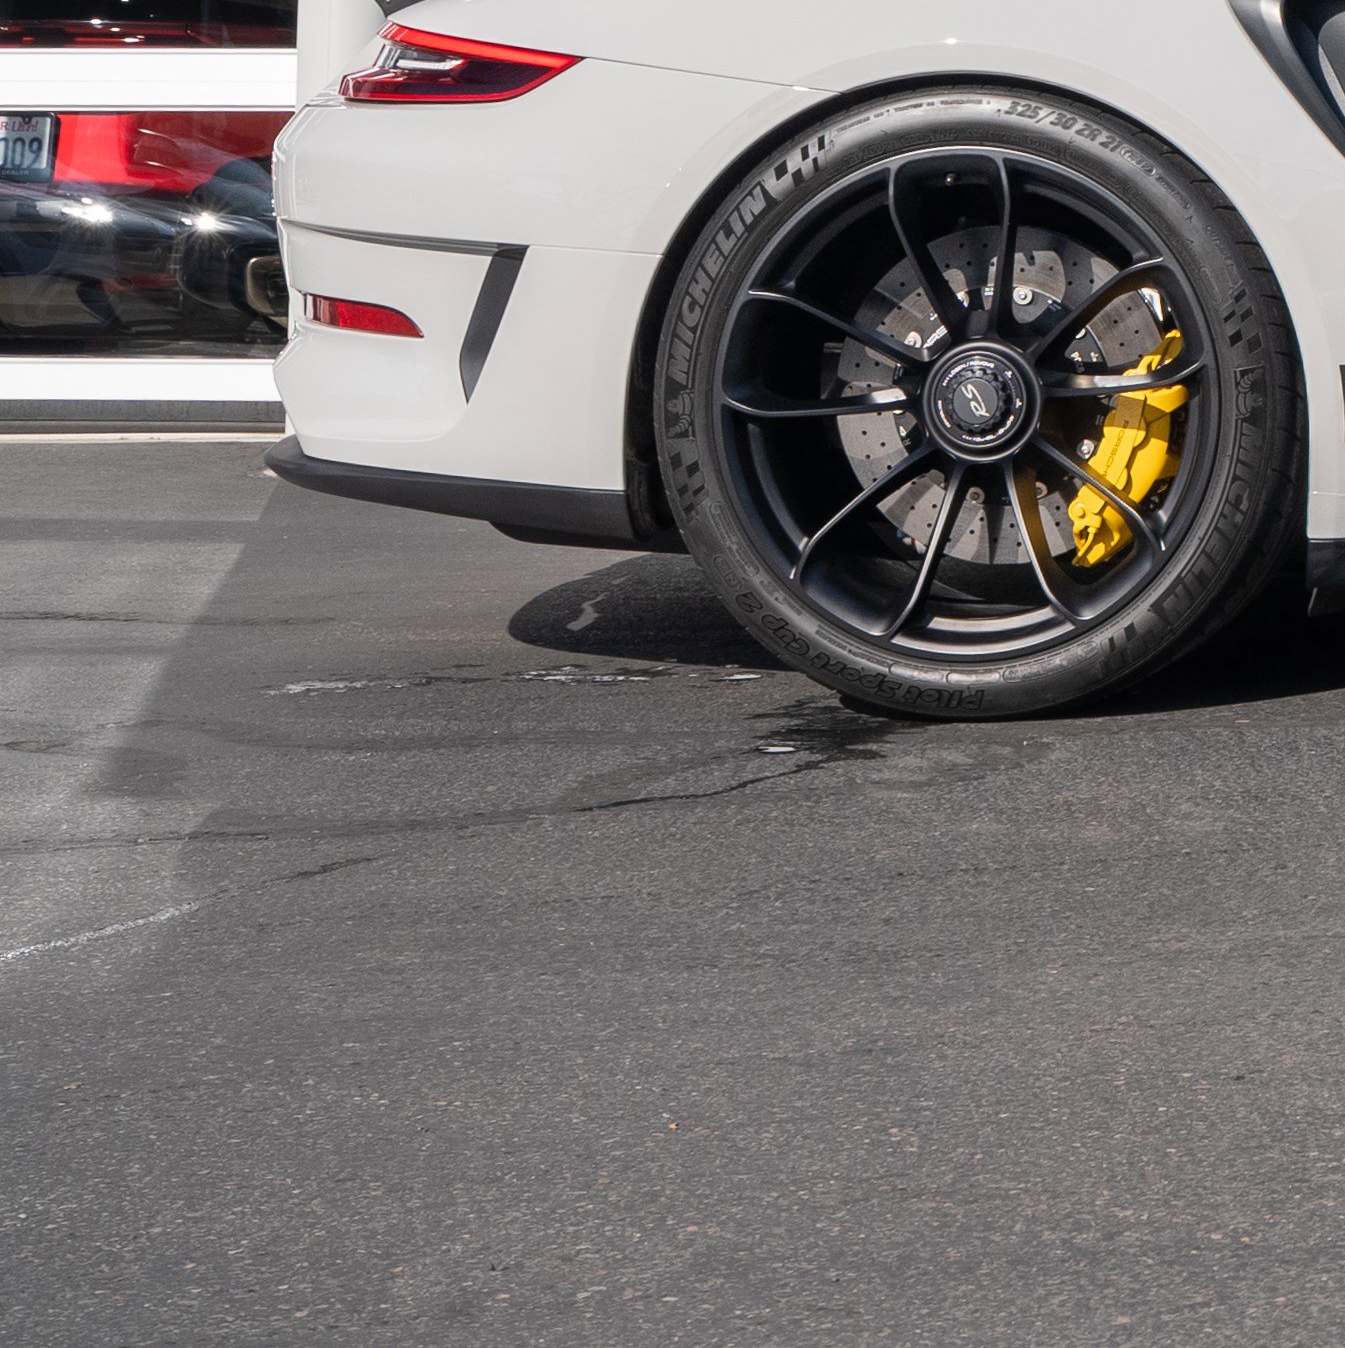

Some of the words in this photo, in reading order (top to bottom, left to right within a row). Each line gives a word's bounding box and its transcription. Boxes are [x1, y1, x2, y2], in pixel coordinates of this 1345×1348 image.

[1004, 100, 1078, 132] 325/30
[668, 180, 768, 387] MICHELIN
[1104, 419, 1130, 477] PORSCH
[1161, 421, 1264, 629] MICHELIN
[761, 612, 811, 658] Cup
[813, 653, 903, 699] Sport
[902, 685, 985, 711] Pilot
